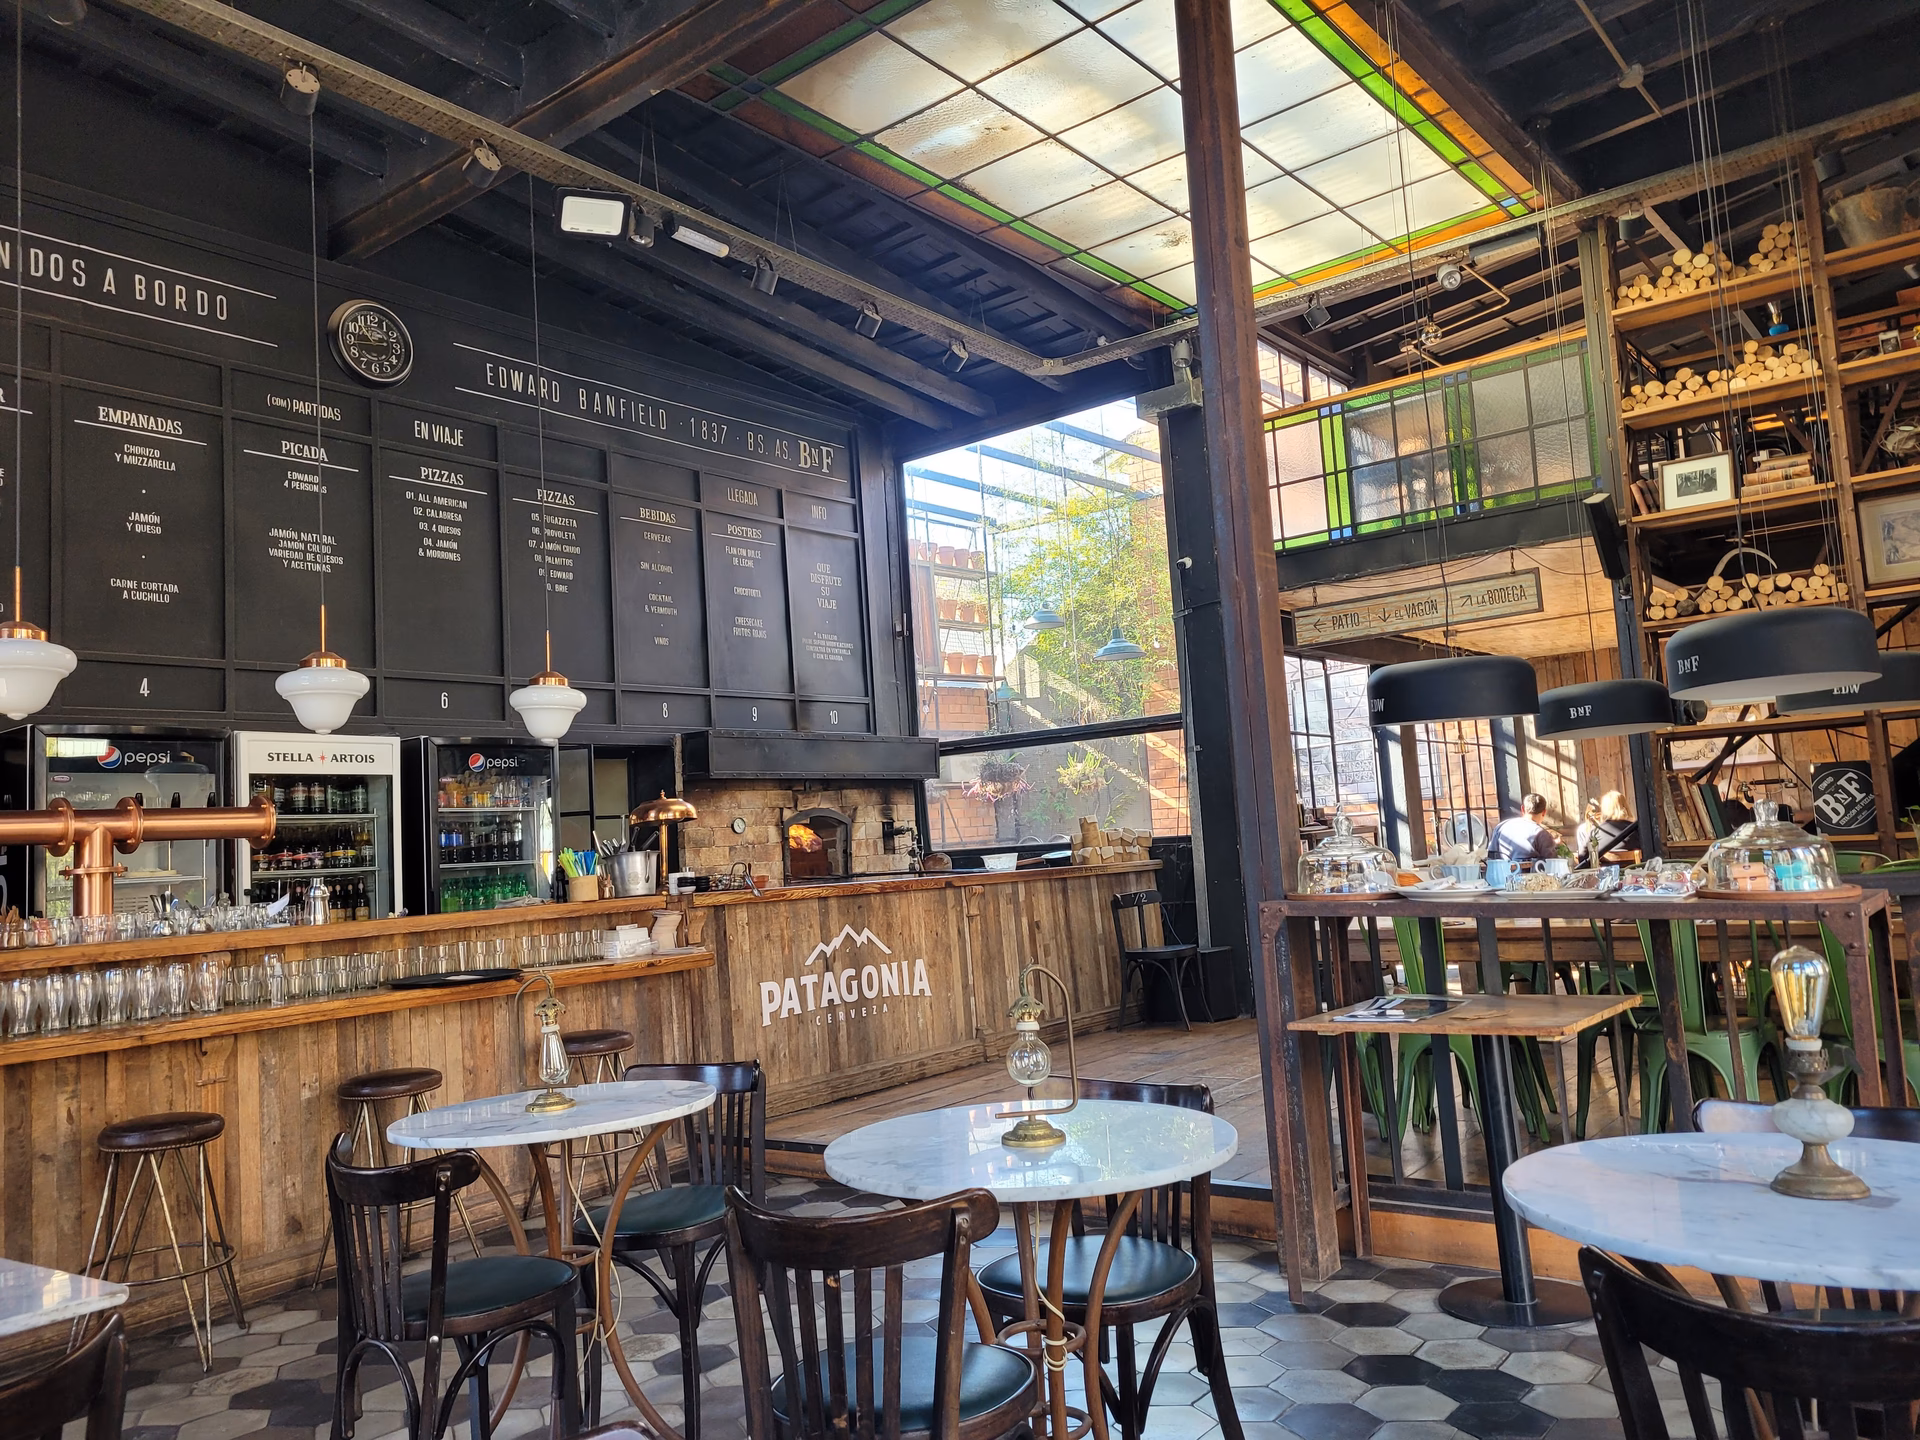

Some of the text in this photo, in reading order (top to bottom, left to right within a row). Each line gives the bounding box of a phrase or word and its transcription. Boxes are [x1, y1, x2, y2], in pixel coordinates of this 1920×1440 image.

[103, 267, 116, 295] A
[134, 273, 228, 321] BORDO
[348, 322, 359, 333] 10
[366, 315, 379, 327] 12
[382, 321, 387, 332] 1
[346, 333, 354, 345] 9
[388, 331, 397, 342] 2
[350, 346, 359, 358] 8
[392, 343, 401, 355] 3
[360, 357, 368, 368] 7
[388, 354, 398, 365] 4
[371, 362, 380, 374] 6
[382, 362, 391, 372] 5
[486, 362, 560, 403] EDWARD
[579, 388, 667, 430] BANFIELD
[690, 417, 727, 445] 1837
[98, 406, 183, 435] EMPANADAS
[414, 420, 464, 447] EN VIAJE
[124, 443, 161, 458] CHORIZO
[281, 440, 329, 462] PICADA
[114, 452, 177, 472] Y MUZZARELLA
[287, 470, 319, 484] EDWARD
[419, 466, 465, 486] PIZZAS
[283, 480, 289, 488] 4
[405, 490, 468, 510] 01. ALL AMERICAN
[536, 488, 576, 506] PIZZAS
[727, 487, 759, 506] LLEGADA
[128, 511, 161, 525] JAMÓN
[413, 506, 463, 523] 02. CALABRESA
[639, 507, 677, 524] BEBIDAS
[811, 504, 827, 520] INFO
[126, 522, 162, 535] Y QUESO
[418, 521, 462, 536] 03. 4 QUESOS
[543, 514, 578, 529] FUGAZZETA
[268, 527, 298, 540] JAMÓN
[643, 531, 672, 544] CERVEZAS
[727, 523, 762, 539] POSTRES
[278, 539, 305, 551] JAMÓN
[435, 539, 458, 550] JAMÓN
[562, 544, 581, 555] CRUDO
[268, 547, 304, 560] VARIEDAD
[306, 553, 315, 562] DE
[418, 547, 461, 562] & MORRONES
[545, 555, 574, 567] PALMITOS
[282, 559, 331, 573] Y ACEITUNAS
[640, 561, 674, 575] SIN ALCOHOL
[740, 558, 755, 568] LECHE
[816, 562, 831, 574] QUE
[550, 569, 574, 580] EDWARD
[810, 573, 842, 587] DISFRUTE
[110, 577, 180, 594] CARNE CORTADA
[820, 586, 830, 596] SU
[122, 589, 170, 604] A CUCHILLO
[1476, 584, 1528, 607] LA BODEGA
[816, 597, 837, 610] VIAJE
[1394, 596, 1439, 620] EL VAGÓN
[1331, 612, 1360, 631] PATIO
[653, 636, 670, 646] VINOS
[139, 677, 150, 697] 4
[440, 692, 449, 709] 6
[662, 702, 669, 718] 8
[752, 706, 758, 722] 9
[829, 710, 838, 725] 10
[124, 750, 171, 766] pepsi
[267, 752, 375, 764] STELLA ARTOIS
[486, 756, 518, 770] pepsi
[759, 958, 932, 1027] PATAGONIA
[816, 1003, 888, 1026] CERVEZA
